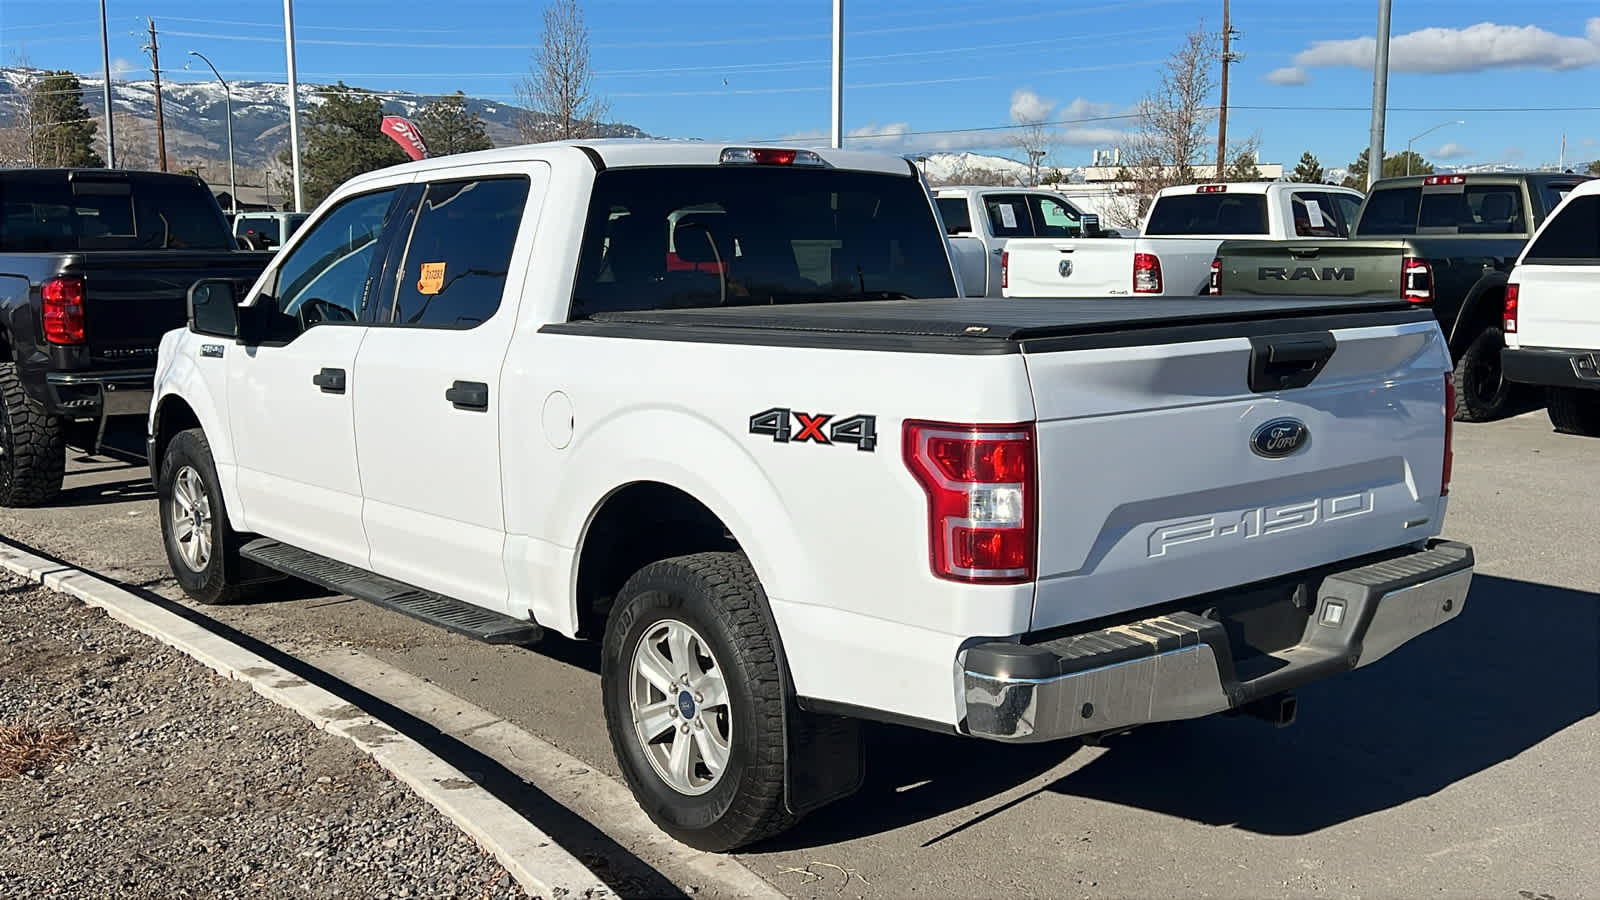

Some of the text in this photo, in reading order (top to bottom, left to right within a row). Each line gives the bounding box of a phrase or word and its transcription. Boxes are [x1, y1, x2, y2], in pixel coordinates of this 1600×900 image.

[1258, 266, 1355, 281] RAM
[1266, 427, 1300, 450] Ford
[1146, 489, 1374, 558] F-150
